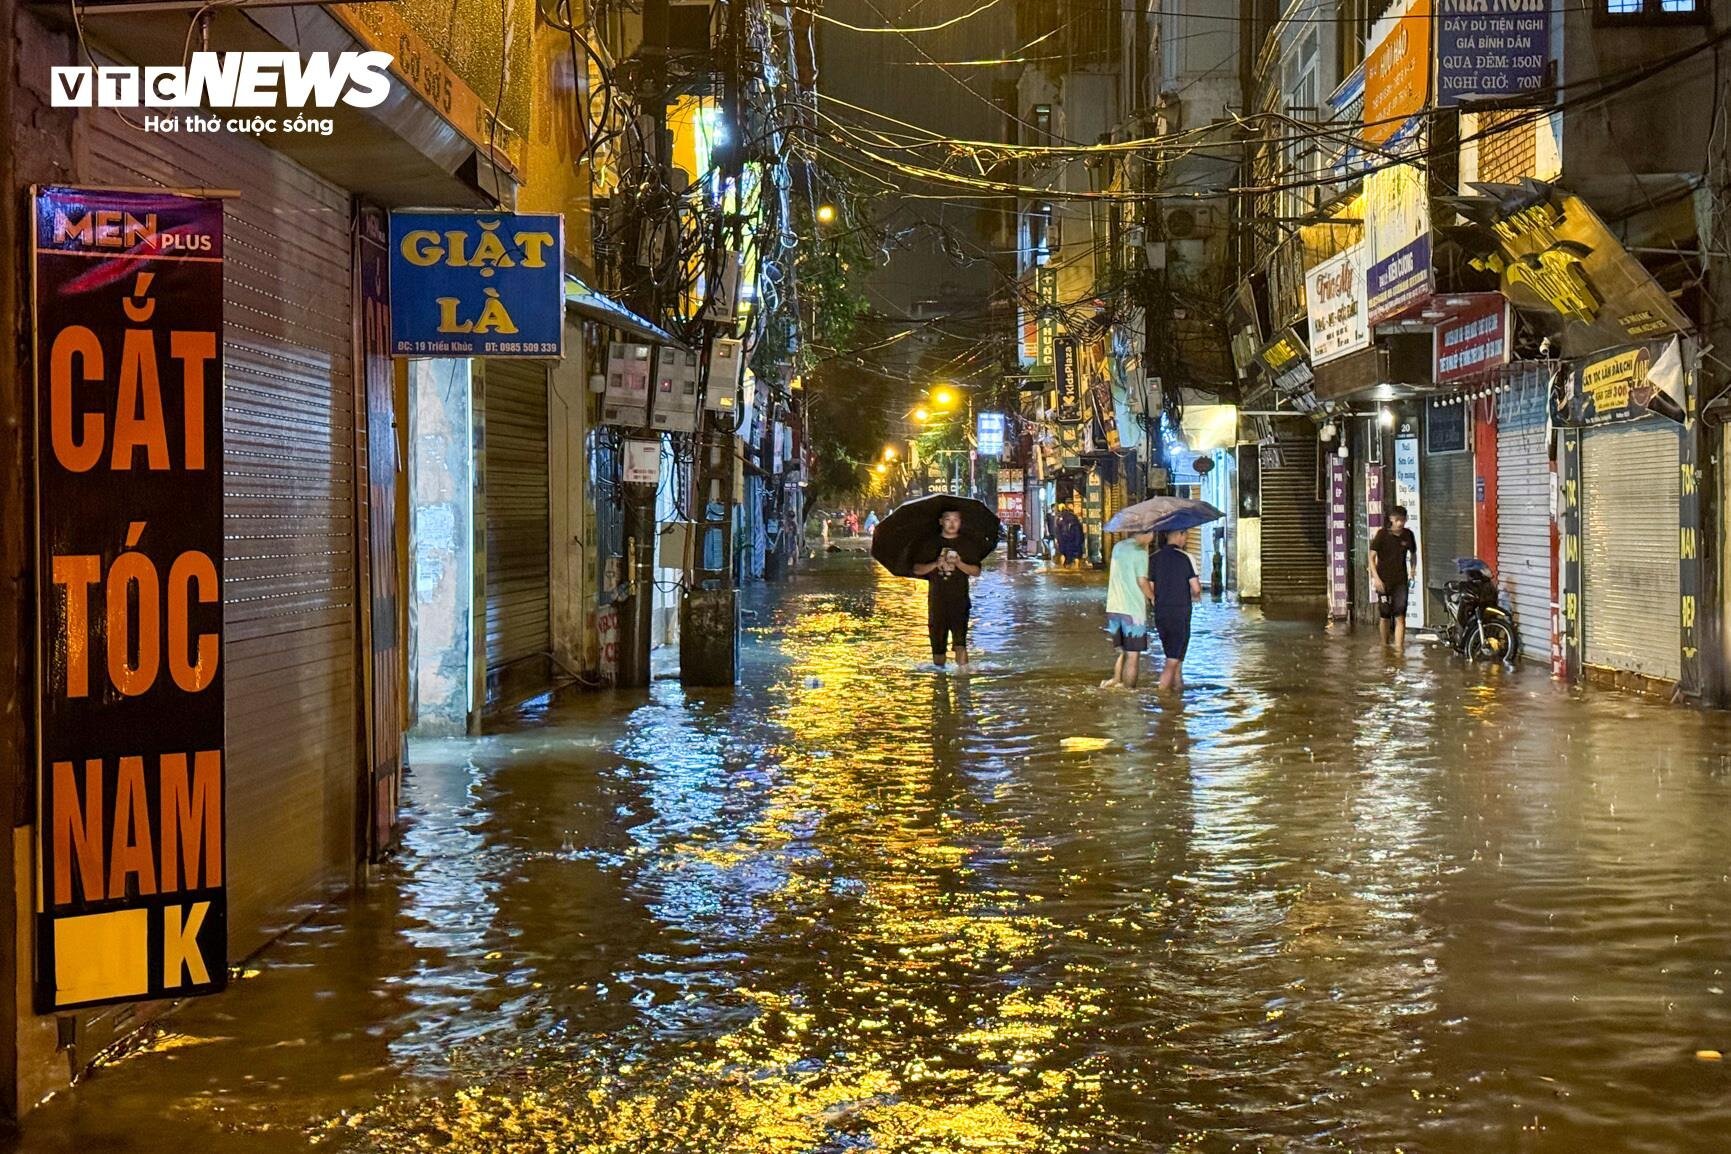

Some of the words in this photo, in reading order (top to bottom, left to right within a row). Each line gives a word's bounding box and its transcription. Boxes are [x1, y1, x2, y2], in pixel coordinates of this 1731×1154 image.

[1456, 34, 1475, 49] GIÁ
[1507, 34, 1531, 48] DÂN
[1517, 19, 1543, 31] NGHI
[1443, 55, 1472, 69] QUA
[1512, 55, 1542, 68] 150N
[1443, 71, 1478, 89] NGHỈ
[1517, 76, 1542, 89] 70N
[53, 208, 158, 249] MEN
[161, 233, 212, 250] PLUS
[401, 219, 554, 278] GIẶT
[436, 287, 519, 334] LÀ
[415, 341, 425, 351] 19
[500, 342, 521, 352] 0985
[523, 342, 539, 352] 509
[540, 342, 557, 352] 339
[50, 272, 217, 474] CẮT
[1064, 345, 1075, 394] KidsPlaza
[1401, 423, 1411, 433] 20
[1680, 527, 1696, 560] NAM
[53, 521, 219, 698] TÓC
[52, 749, 222, 906] NAM
[163, 901, 211, 989] K
